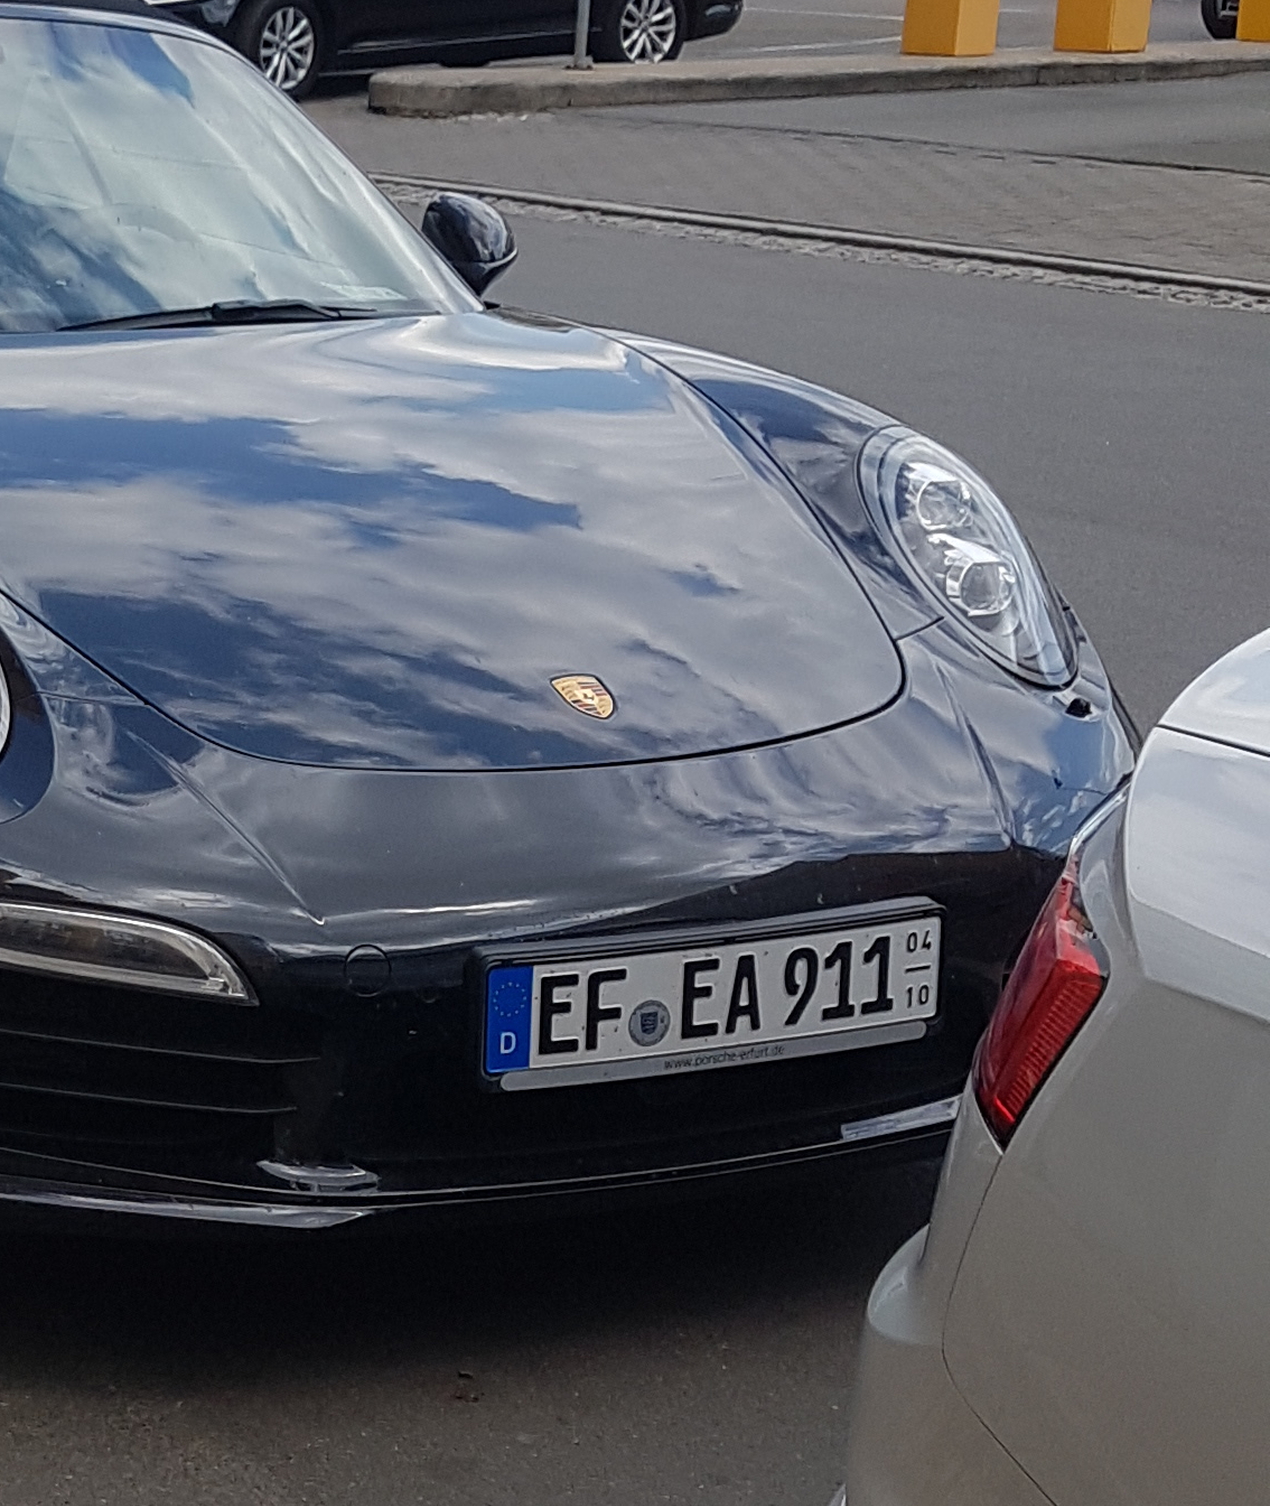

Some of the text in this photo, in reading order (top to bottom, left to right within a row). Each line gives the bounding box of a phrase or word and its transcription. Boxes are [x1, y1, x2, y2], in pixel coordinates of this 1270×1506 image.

[906, 928, 933, 954] 04
[499, 935, 894, 1055] D EF EA 911
[906, 983, 930, 1009] 10
[663, 1044, 785, 1071] www.porsche-erfurt.de
